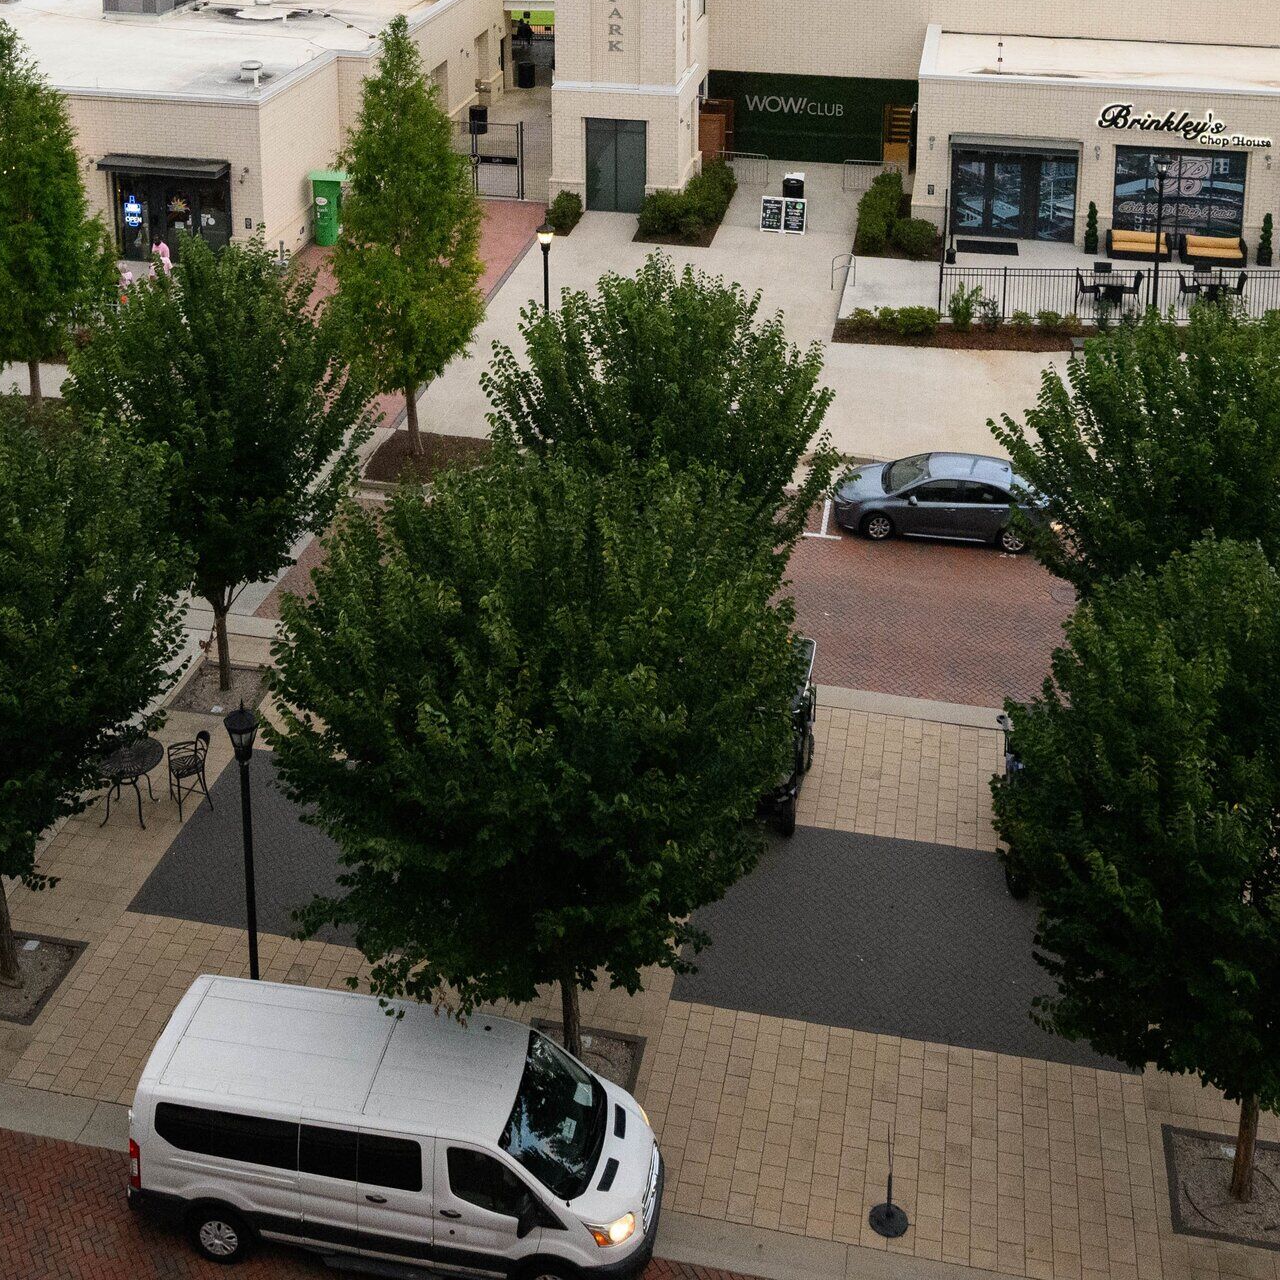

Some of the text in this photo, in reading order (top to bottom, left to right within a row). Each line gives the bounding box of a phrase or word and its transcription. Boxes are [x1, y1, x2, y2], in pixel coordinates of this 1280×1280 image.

[745, 94, 844, 117] WOW! CLUB
[1097, 103, 1228, 141] Brinkley's
[1199, 135, 1272, 148] Chop House
